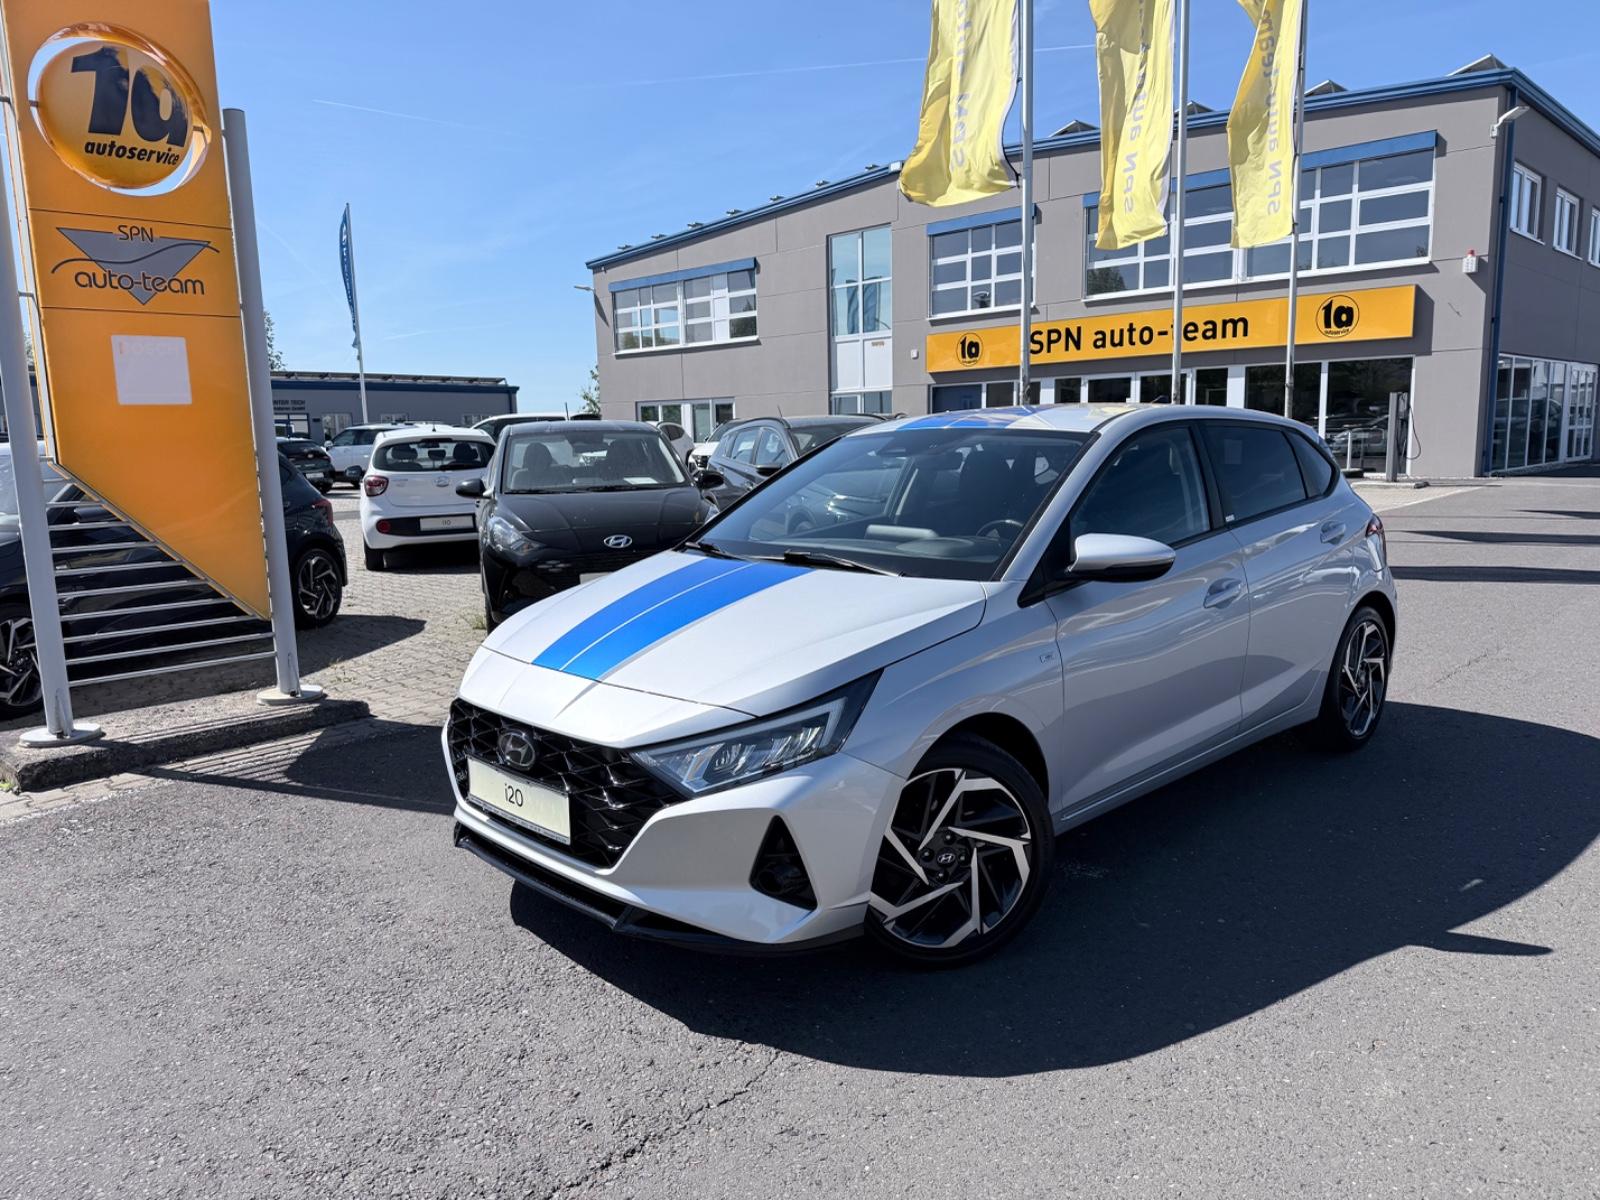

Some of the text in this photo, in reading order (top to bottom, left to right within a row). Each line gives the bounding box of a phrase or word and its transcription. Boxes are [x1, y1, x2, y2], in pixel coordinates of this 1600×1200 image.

[71, 46, 188, 147] 1a
[84, 140, 180, 166] autoservice
[117, 224, 154, 243] SPN
[74, 270, 205, 295] auto-team
[1322, 299, 1354, 329] 1a
[960, 336, 980, 359] 1a
[1029, 316, 1249, 355] SPN auto-eam
[504, 783, 524, 808] i20
